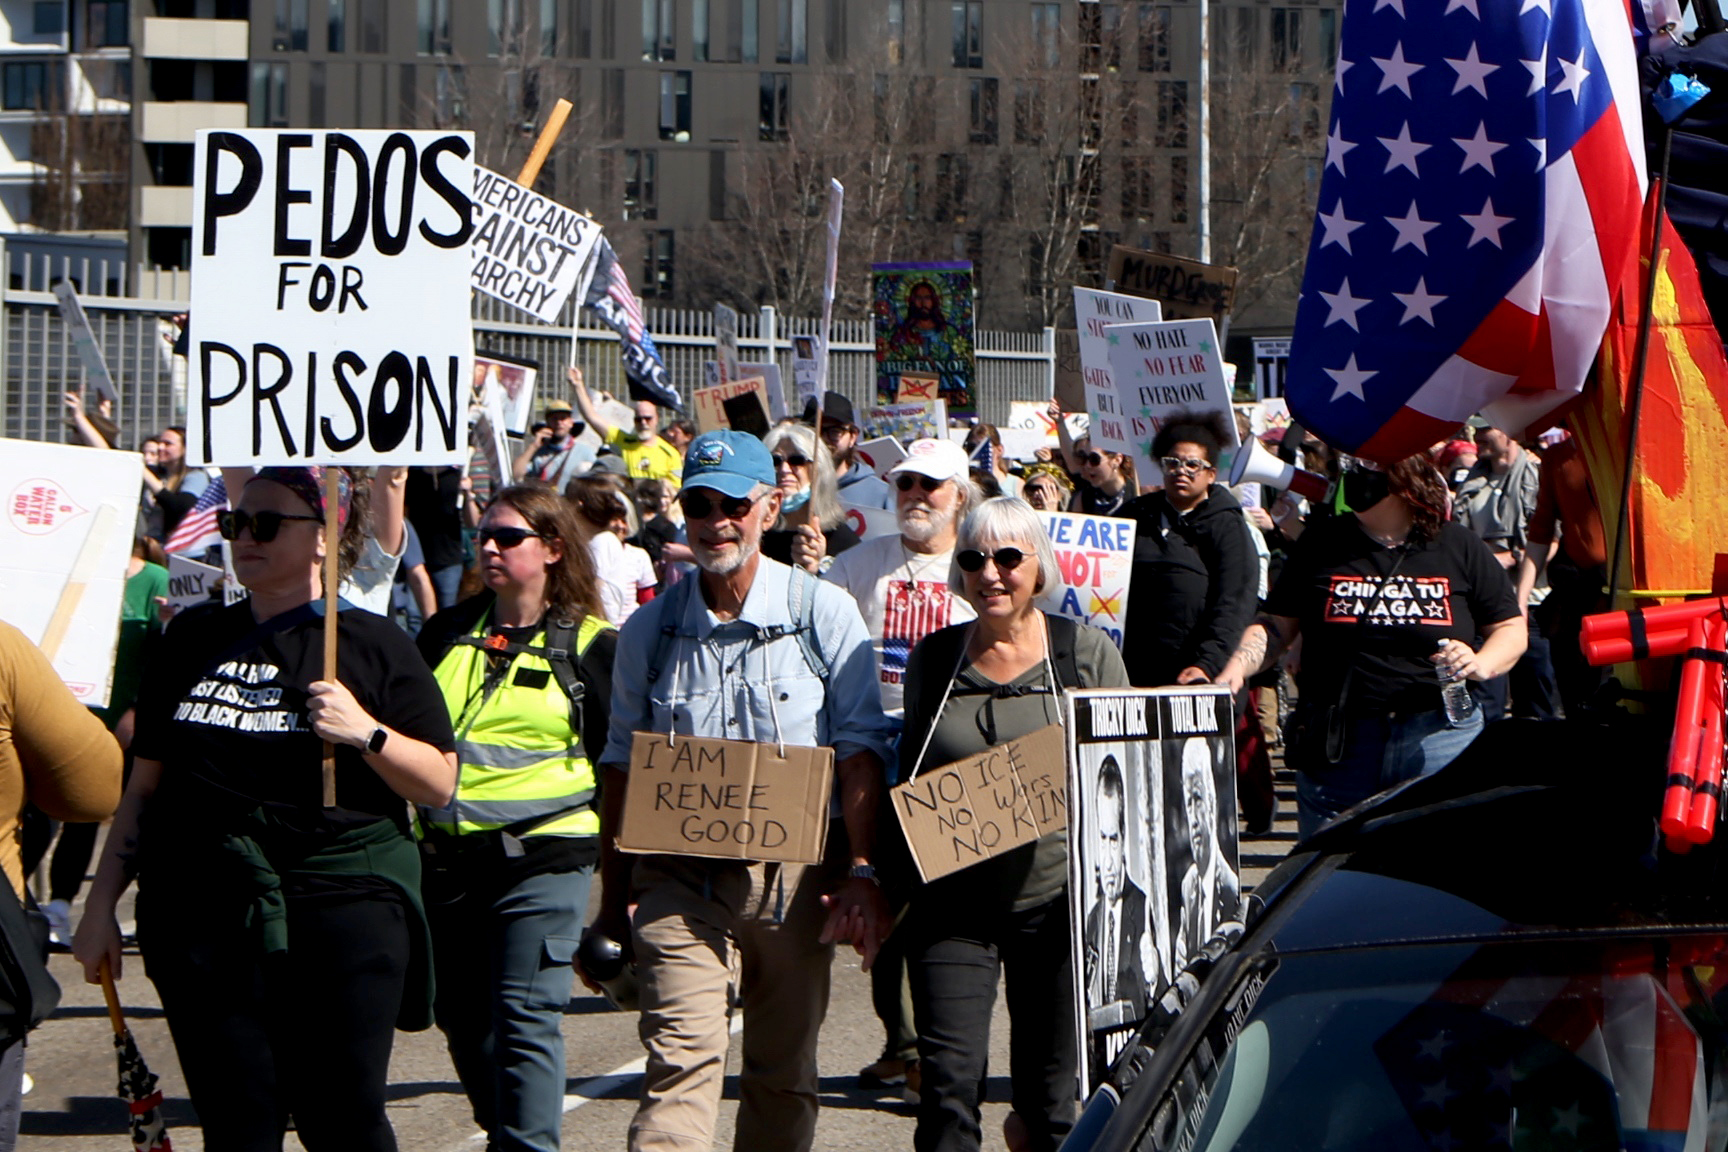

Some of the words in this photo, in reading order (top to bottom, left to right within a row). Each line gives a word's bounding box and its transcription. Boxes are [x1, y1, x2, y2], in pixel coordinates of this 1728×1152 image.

[202, 131, 473, 259] PEDOS
[473, 168, 588, 247] MERICANS
[277, 262, 368, 313] FOR
[1094, 296, 1114, 316] YOU
[1115, 301, 1134, 321] CAN
[1133, 331, 1152, 350] NO
[1155, 328, 1190, 348] HATE
[887, 360, 912, 373] BIG
[1084, 366, 1111, 390] GATES
[1144, 359, 1165, 377] NO
[1169, 354, 1206, 375] FEAR
[200, 341, 459, 464] PRISON
[695, 380, 760, 410] TRUMP
[1097, 393, 1114, 415] BUT
[1138, 382, 1209, 407] EVERYONE
[1101, 419, 1125, 441] BACK
[1131, 416, 1147, 437] IS
[13, 494, 28, 516] BOX
[27, 487, 45, 525] WATER
[1078, 519, 1130, 552] ARE
[1055, 550, 1109, 588] NOT
[169, 574, 205, 597] ONLY
[1335, 581, 1414, 599] CHINGA
[1415, 583, 1444, 599] TU
[1060, 588, 1083, 617] A
[188, 702, 242, 728] BLACK
[1089, 698, 1124, 737] TRICKY
[1126, 698, 1148, 736] DICK
[1169, 697, 1197, 734] TOTAL
[1197, 696, 1218, 733] DICK
[643, 740, 660, 769] I
[671, 742, 725, 777] AM
[901, 772, 964, 817] NO
[973, 743, 1026, 790] ICE
[655, 782, 770, 811] RENEE
[681, 815, 787, 848] GOOD
[938, 807, 972, 834] NO
[953, 821, 1001, 862] NO
